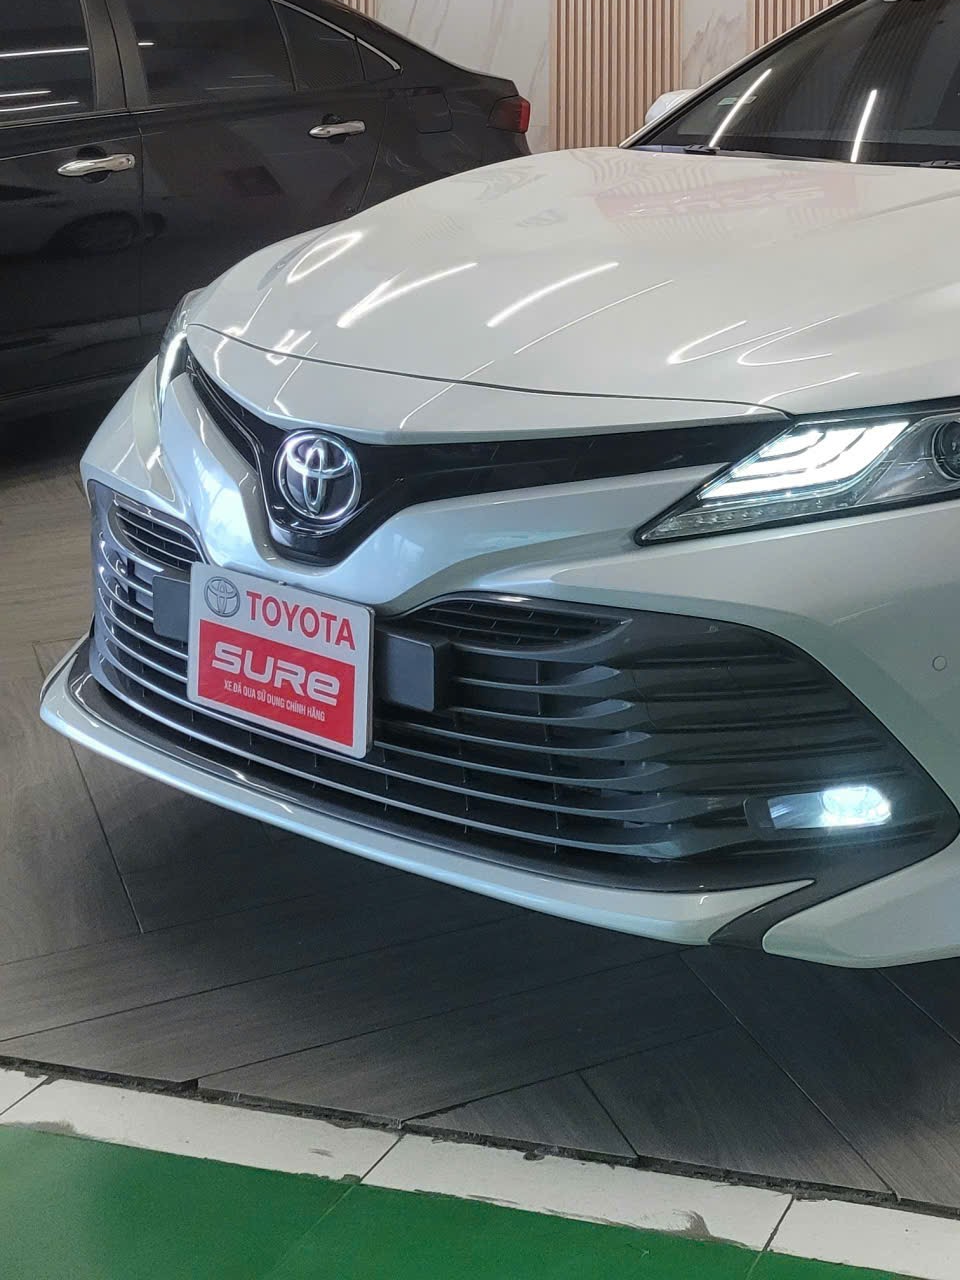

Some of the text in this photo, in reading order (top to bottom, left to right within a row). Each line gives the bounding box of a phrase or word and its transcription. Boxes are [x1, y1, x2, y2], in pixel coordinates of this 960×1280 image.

[246, 590, 356, 651] TOYOTA
[224, 679, 233, 691] XE
[243, 686, 256, 699] QUA
